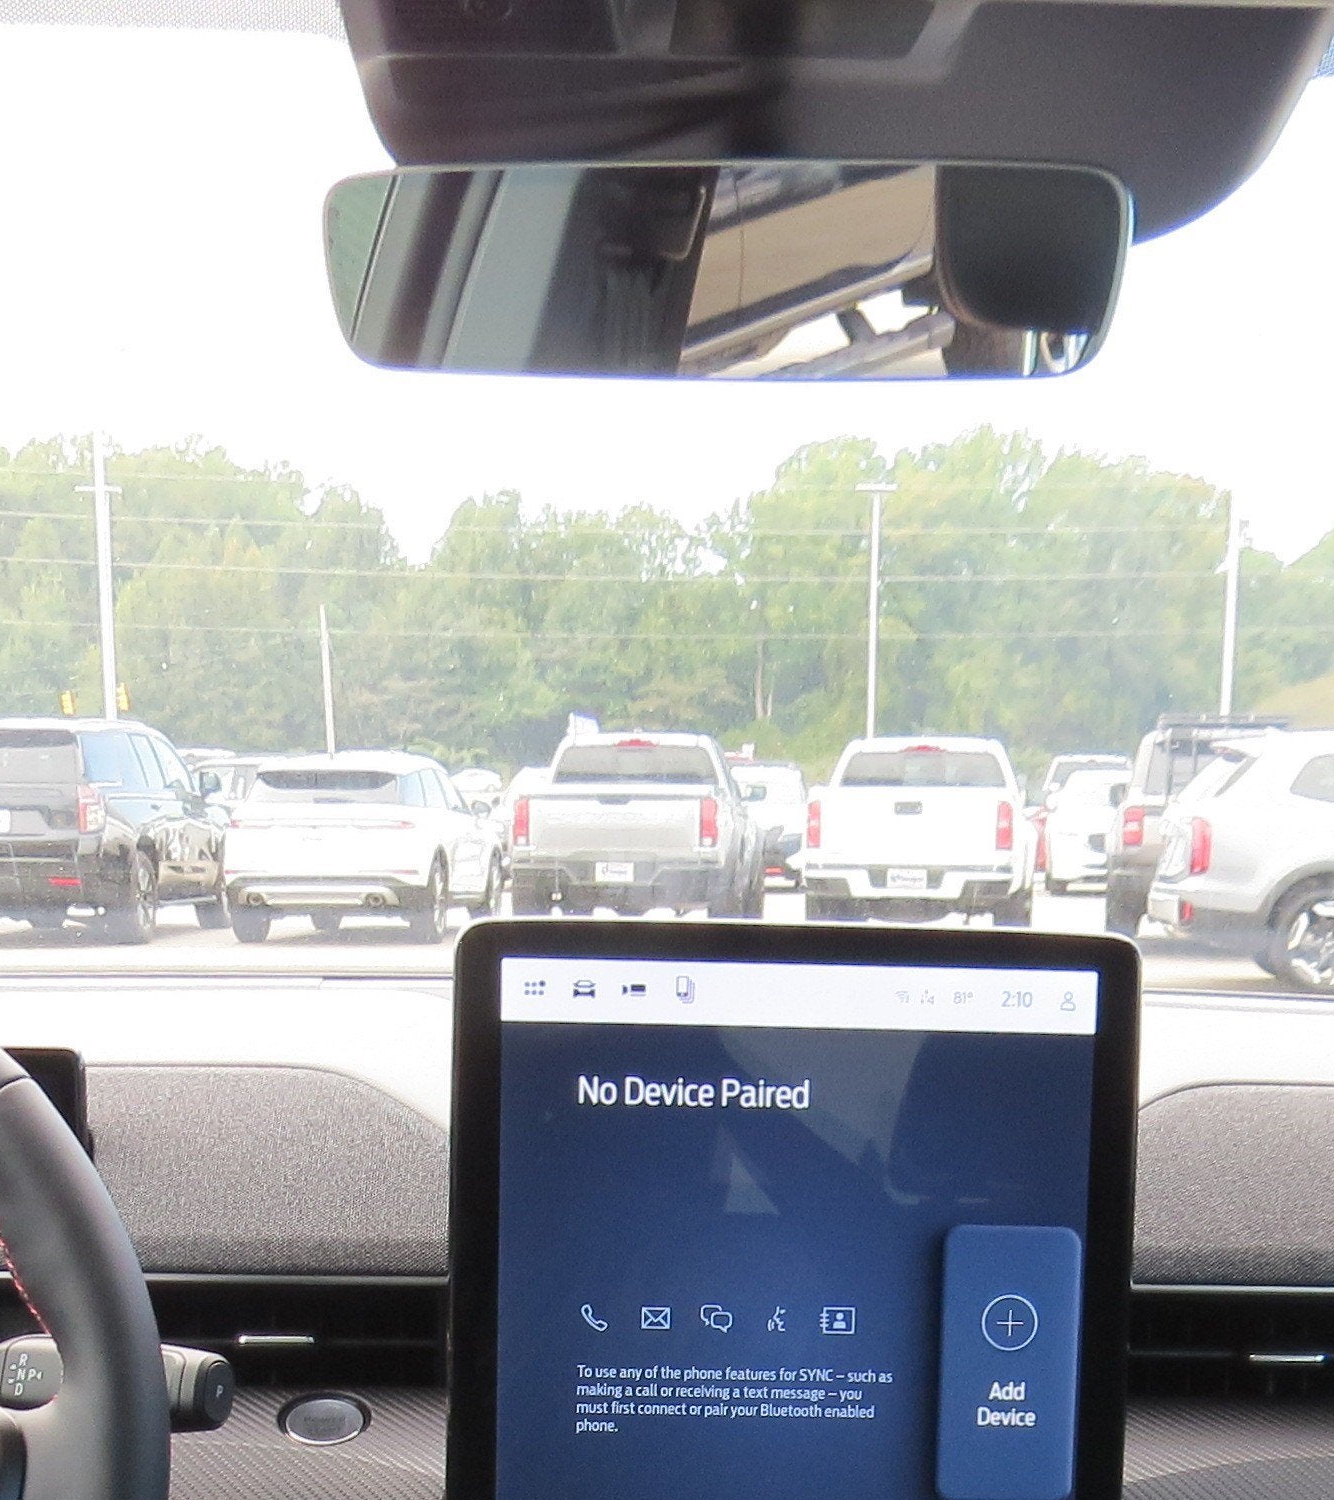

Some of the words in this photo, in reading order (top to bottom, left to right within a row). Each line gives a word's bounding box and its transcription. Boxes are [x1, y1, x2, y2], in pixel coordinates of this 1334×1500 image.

[1001, 990, 1033, 1008] 2:10
[577, 1076, 618, 1107] No
[624, 1076, 714, 1109] Device
[720, 1078, 810, 1110] Paired
[18, 1354, 28, 1366] R
[16, 1369, 26, 1380] N
[27, 1369, 35, 1380] P
[577, 1364, 593, 1378] To
[595, 1367, 616, 1379] use
[619, 1367, 643, 1381] any
[644, 1365, 659, 1379] of
[661, 1366, 681, 1379] the
[683, 1366, 723, 1382] phone
[725, 1366, 777, 1381] features
[779, 1367, 798, 1382] for
[799, 1369, 834, 1382] SYNC
[847, 1369, 876, 1383] such
[878, 1373, 893, 1383] as
[14, 1383, 24, 1396] D
[215, 1385, 223, 1397] P
[576, 1383, 622, 1398] making
[624, 1386, 633, 1397] a
[635, 1383, 658, 1397] call
[660, 1386, 673, 1398] or
[675, 1385, 730, 1401] receiving
[732, 1388, 740, 1399] a
[743, 1387, 769, 1399] text
[770, 1389, 826, 1402] message
[839, 1389, 862, 1403] you
[988, 1380, 1025, 1403] Add
[576, 1402, 608, 1414] must
[610, 1401, 636, 1415] first
[637, 1403, 687, 1415] connect
[689, 1405, 703, 1415] or
[704, 1403, 729, 1418] pair
[730, 1406, 759, 1418] your
[760, 1404, 822, 1418] Bluetooth
[824, 1405, 875, 1419] enabled
[976, 1406, 1036, 1428] Device
[576, 1419, 619, 1434] phone.
